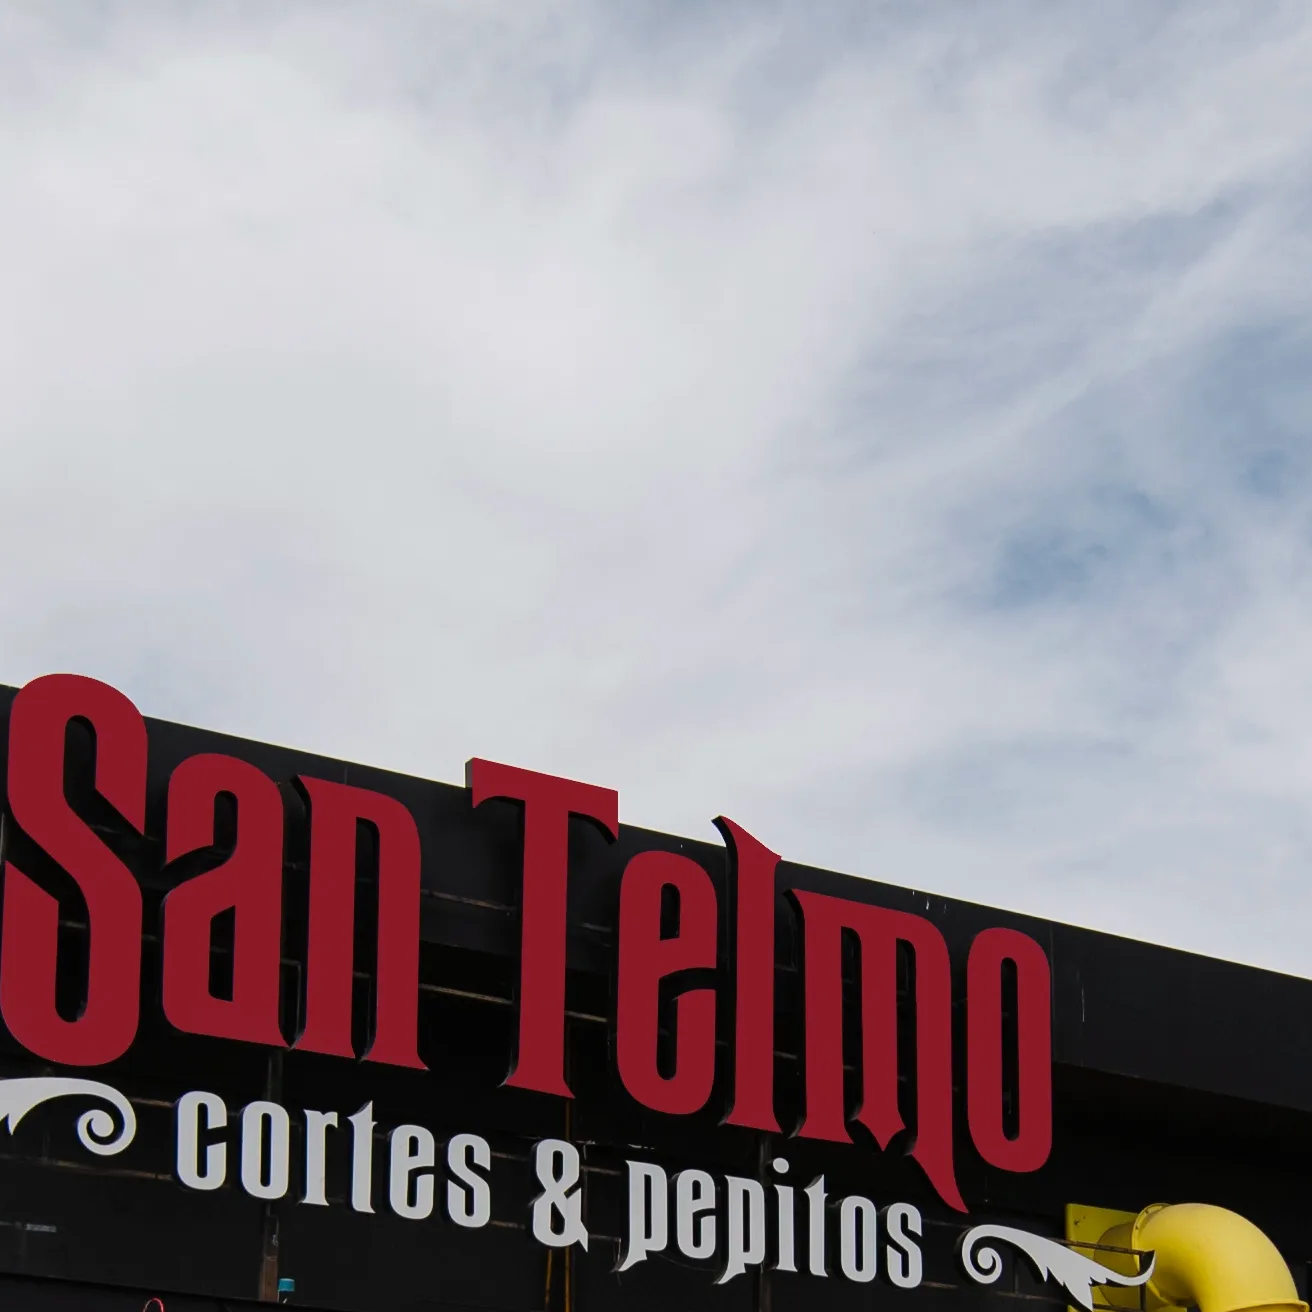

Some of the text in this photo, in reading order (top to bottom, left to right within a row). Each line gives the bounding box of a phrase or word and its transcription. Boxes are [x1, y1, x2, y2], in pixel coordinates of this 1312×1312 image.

[468, 756, 1054, 1214] Telmo
[177, 1089, 924, 1289] cortes & pepitos
